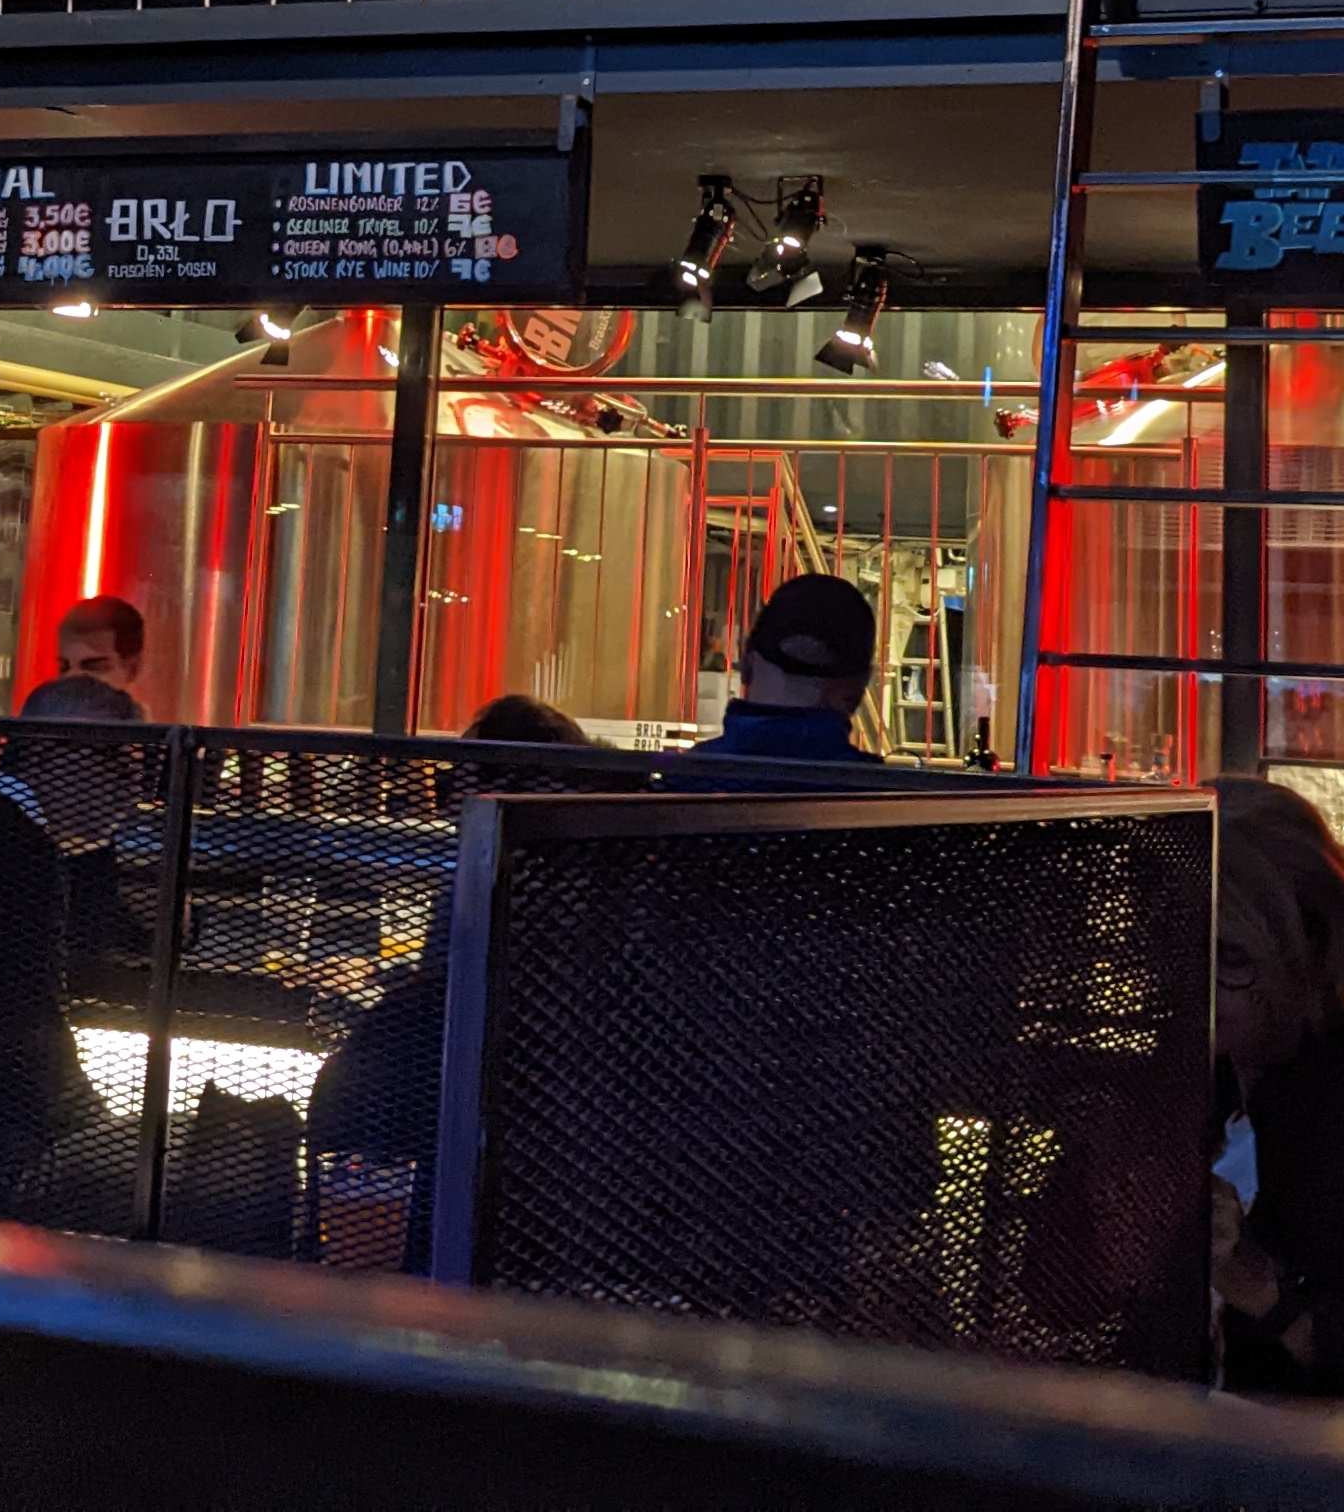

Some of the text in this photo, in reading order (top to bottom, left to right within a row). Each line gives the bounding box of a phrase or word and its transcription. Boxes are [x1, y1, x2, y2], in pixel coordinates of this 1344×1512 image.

[305, 160, 472, 196] LIMITED
[288, 196, 403, 212] ROSINENBOMBER
[286, 218, 404, 237] BERLINER TRIPEL
[283, 239, 377, 257] QUEEN KONG
[108, 262, 217, 278] FLASCHEN DOSEN
[284, 260, 411, 280] STORK RYE WINE
